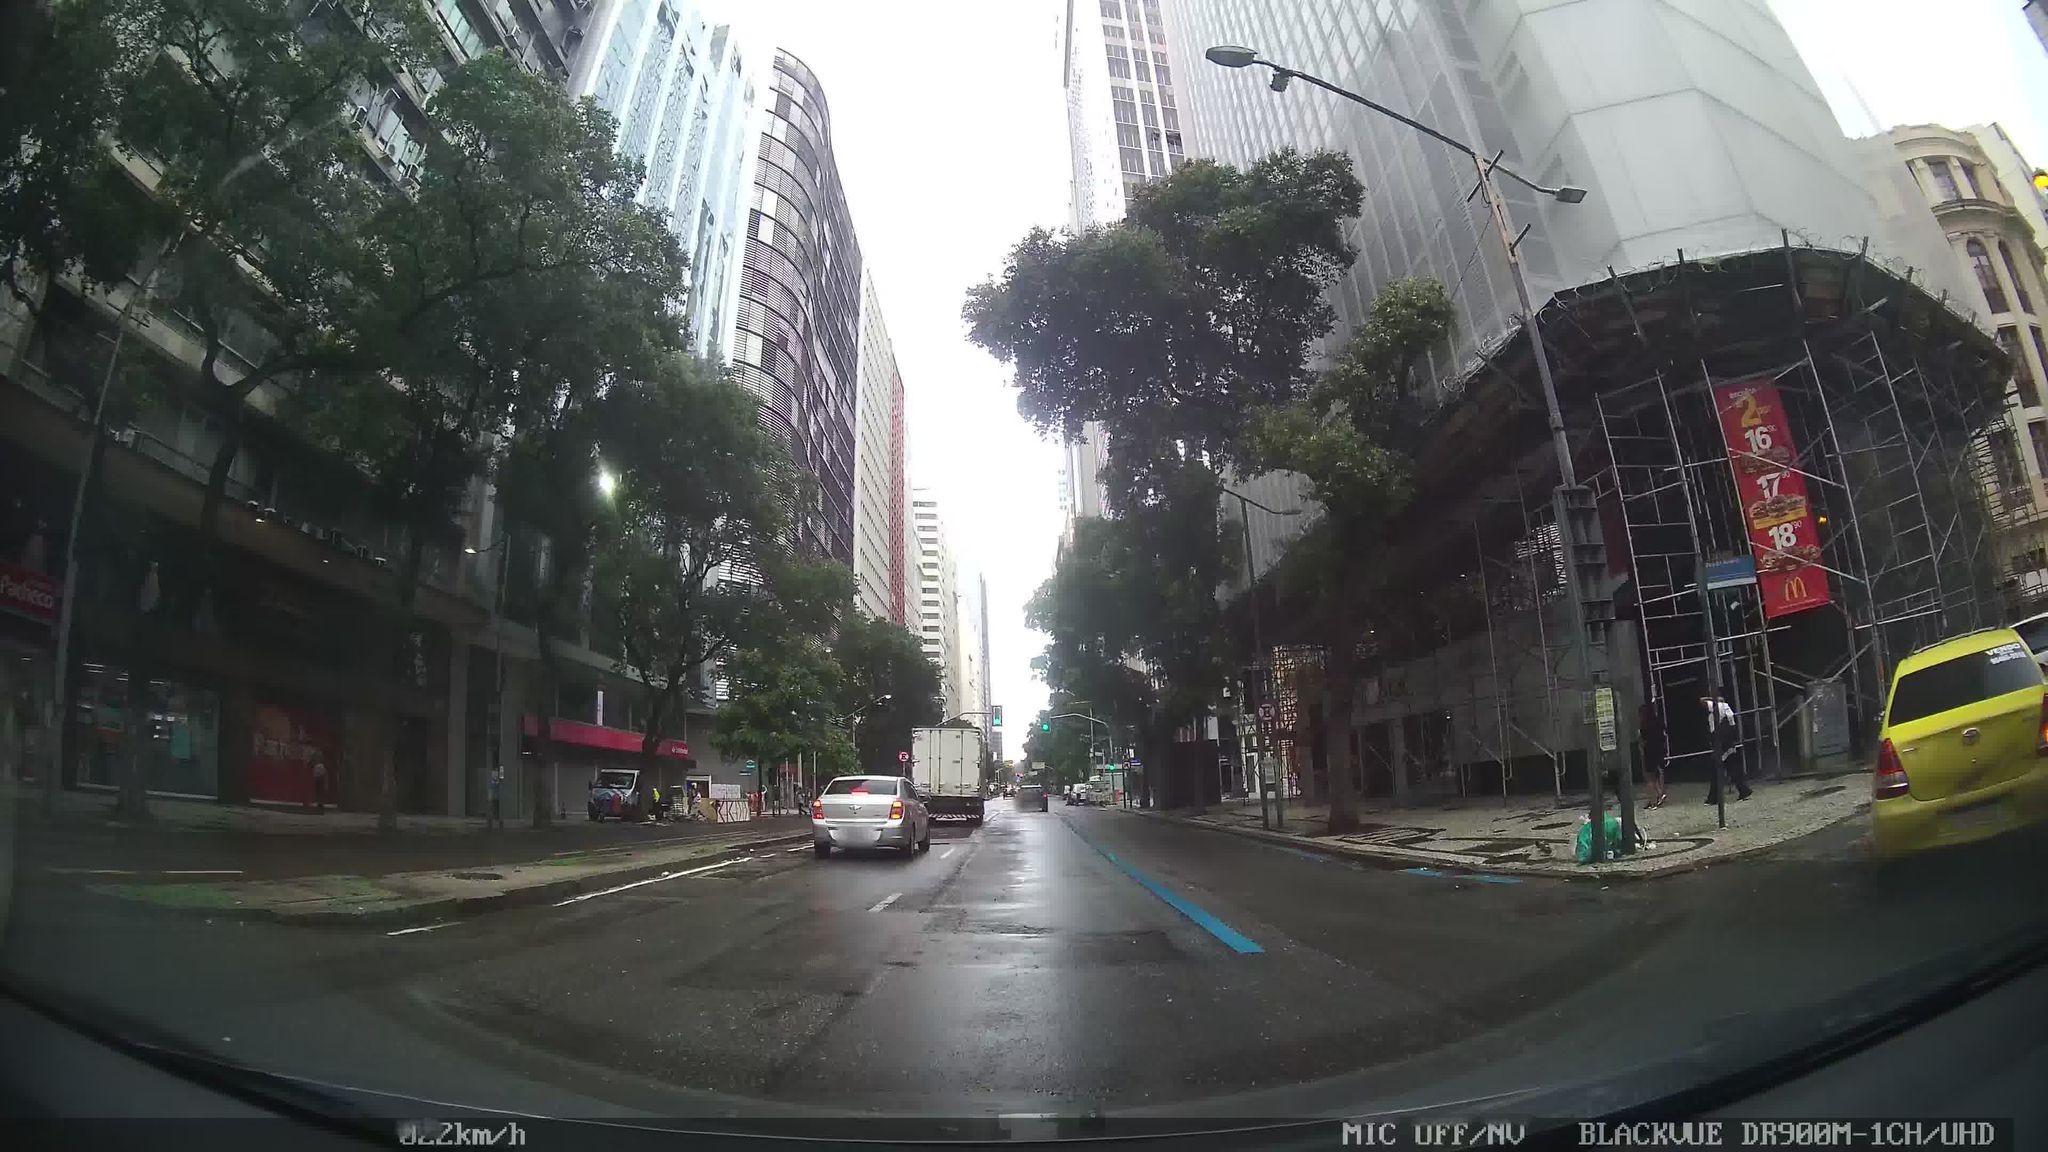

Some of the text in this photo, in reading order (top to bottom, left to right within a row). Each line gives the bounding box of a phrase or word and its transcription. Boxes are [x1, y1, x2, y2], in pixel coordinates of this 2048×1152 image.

[1741, 394, 1762, 428] 2
[1744, 426, 1772, 455] 16
[1756, 472, 1781, 498] 17
[1768, 523, 1796, 550] 18
